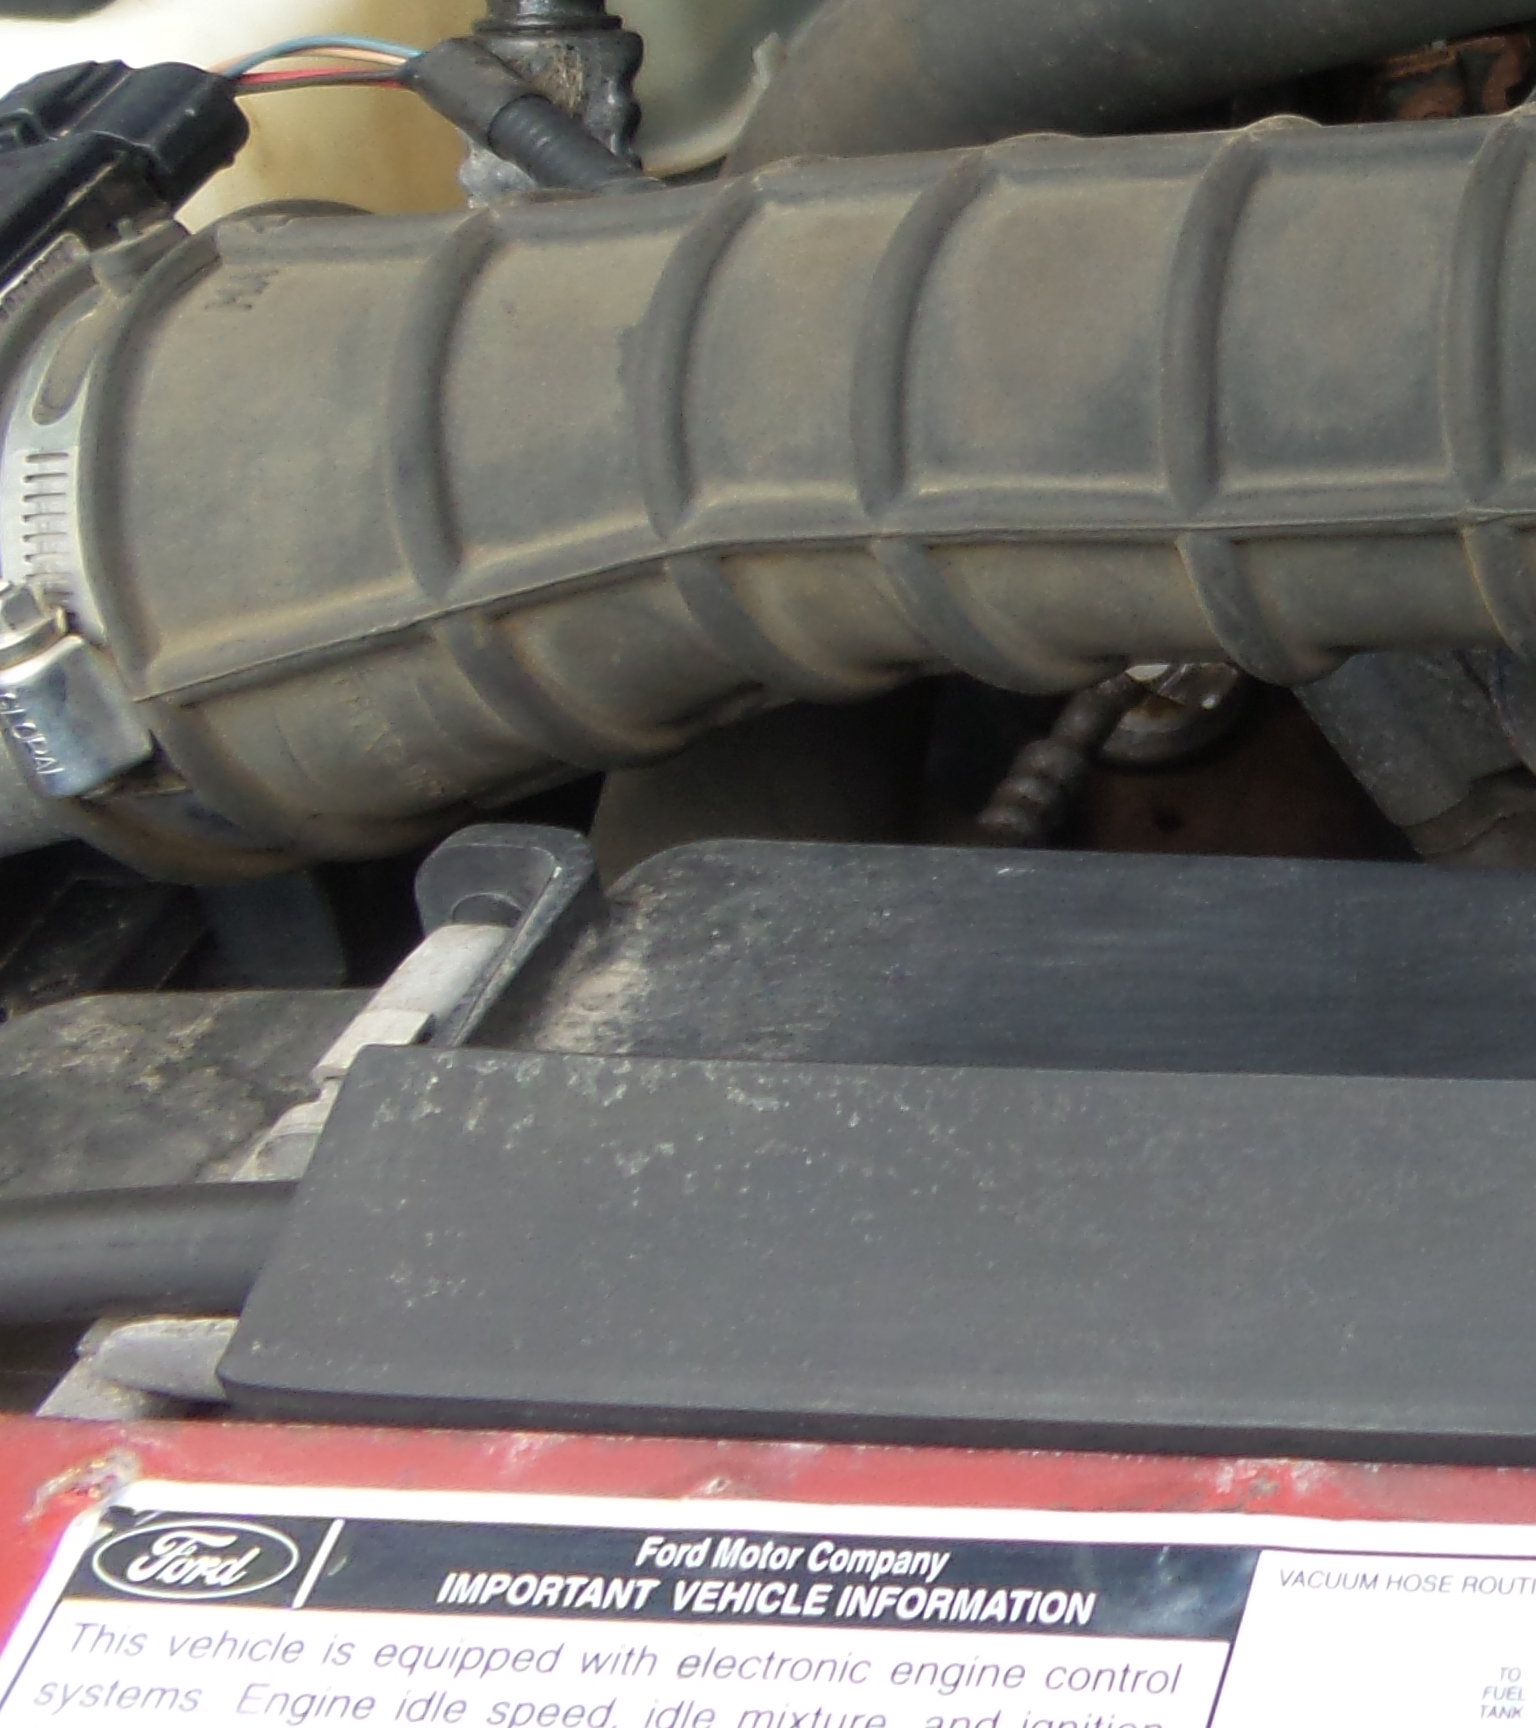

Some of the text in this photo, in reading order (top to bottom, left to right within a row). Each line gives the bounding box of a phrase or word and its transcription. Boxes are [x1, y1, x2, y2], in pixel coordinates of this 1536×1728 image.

[127, 1529, 263, 1589] Ford
[635, 1534, 951, 1583] Ford Motor Company
[1280, 1569, 1378, 1591] VACUUM
[1386, 1574, 1452, 1594] HOSE
[436, 1571, 1097, 1626] IMPORTANT VEHICLE INFORMATION
[68, 1621, 1184, 1696] This vehicle is equipped with electronic engine control
[1499, 1666, 1522, 1683] TO
[234, 1682, 377, 1726] Engine
[394, 1689, 467, 1725] idle
[643, 1699, 717, 1728] idle
[1479, 1704, 1523, 1720] TANK
[1482, 1685, 1527, 1703] FUEL
